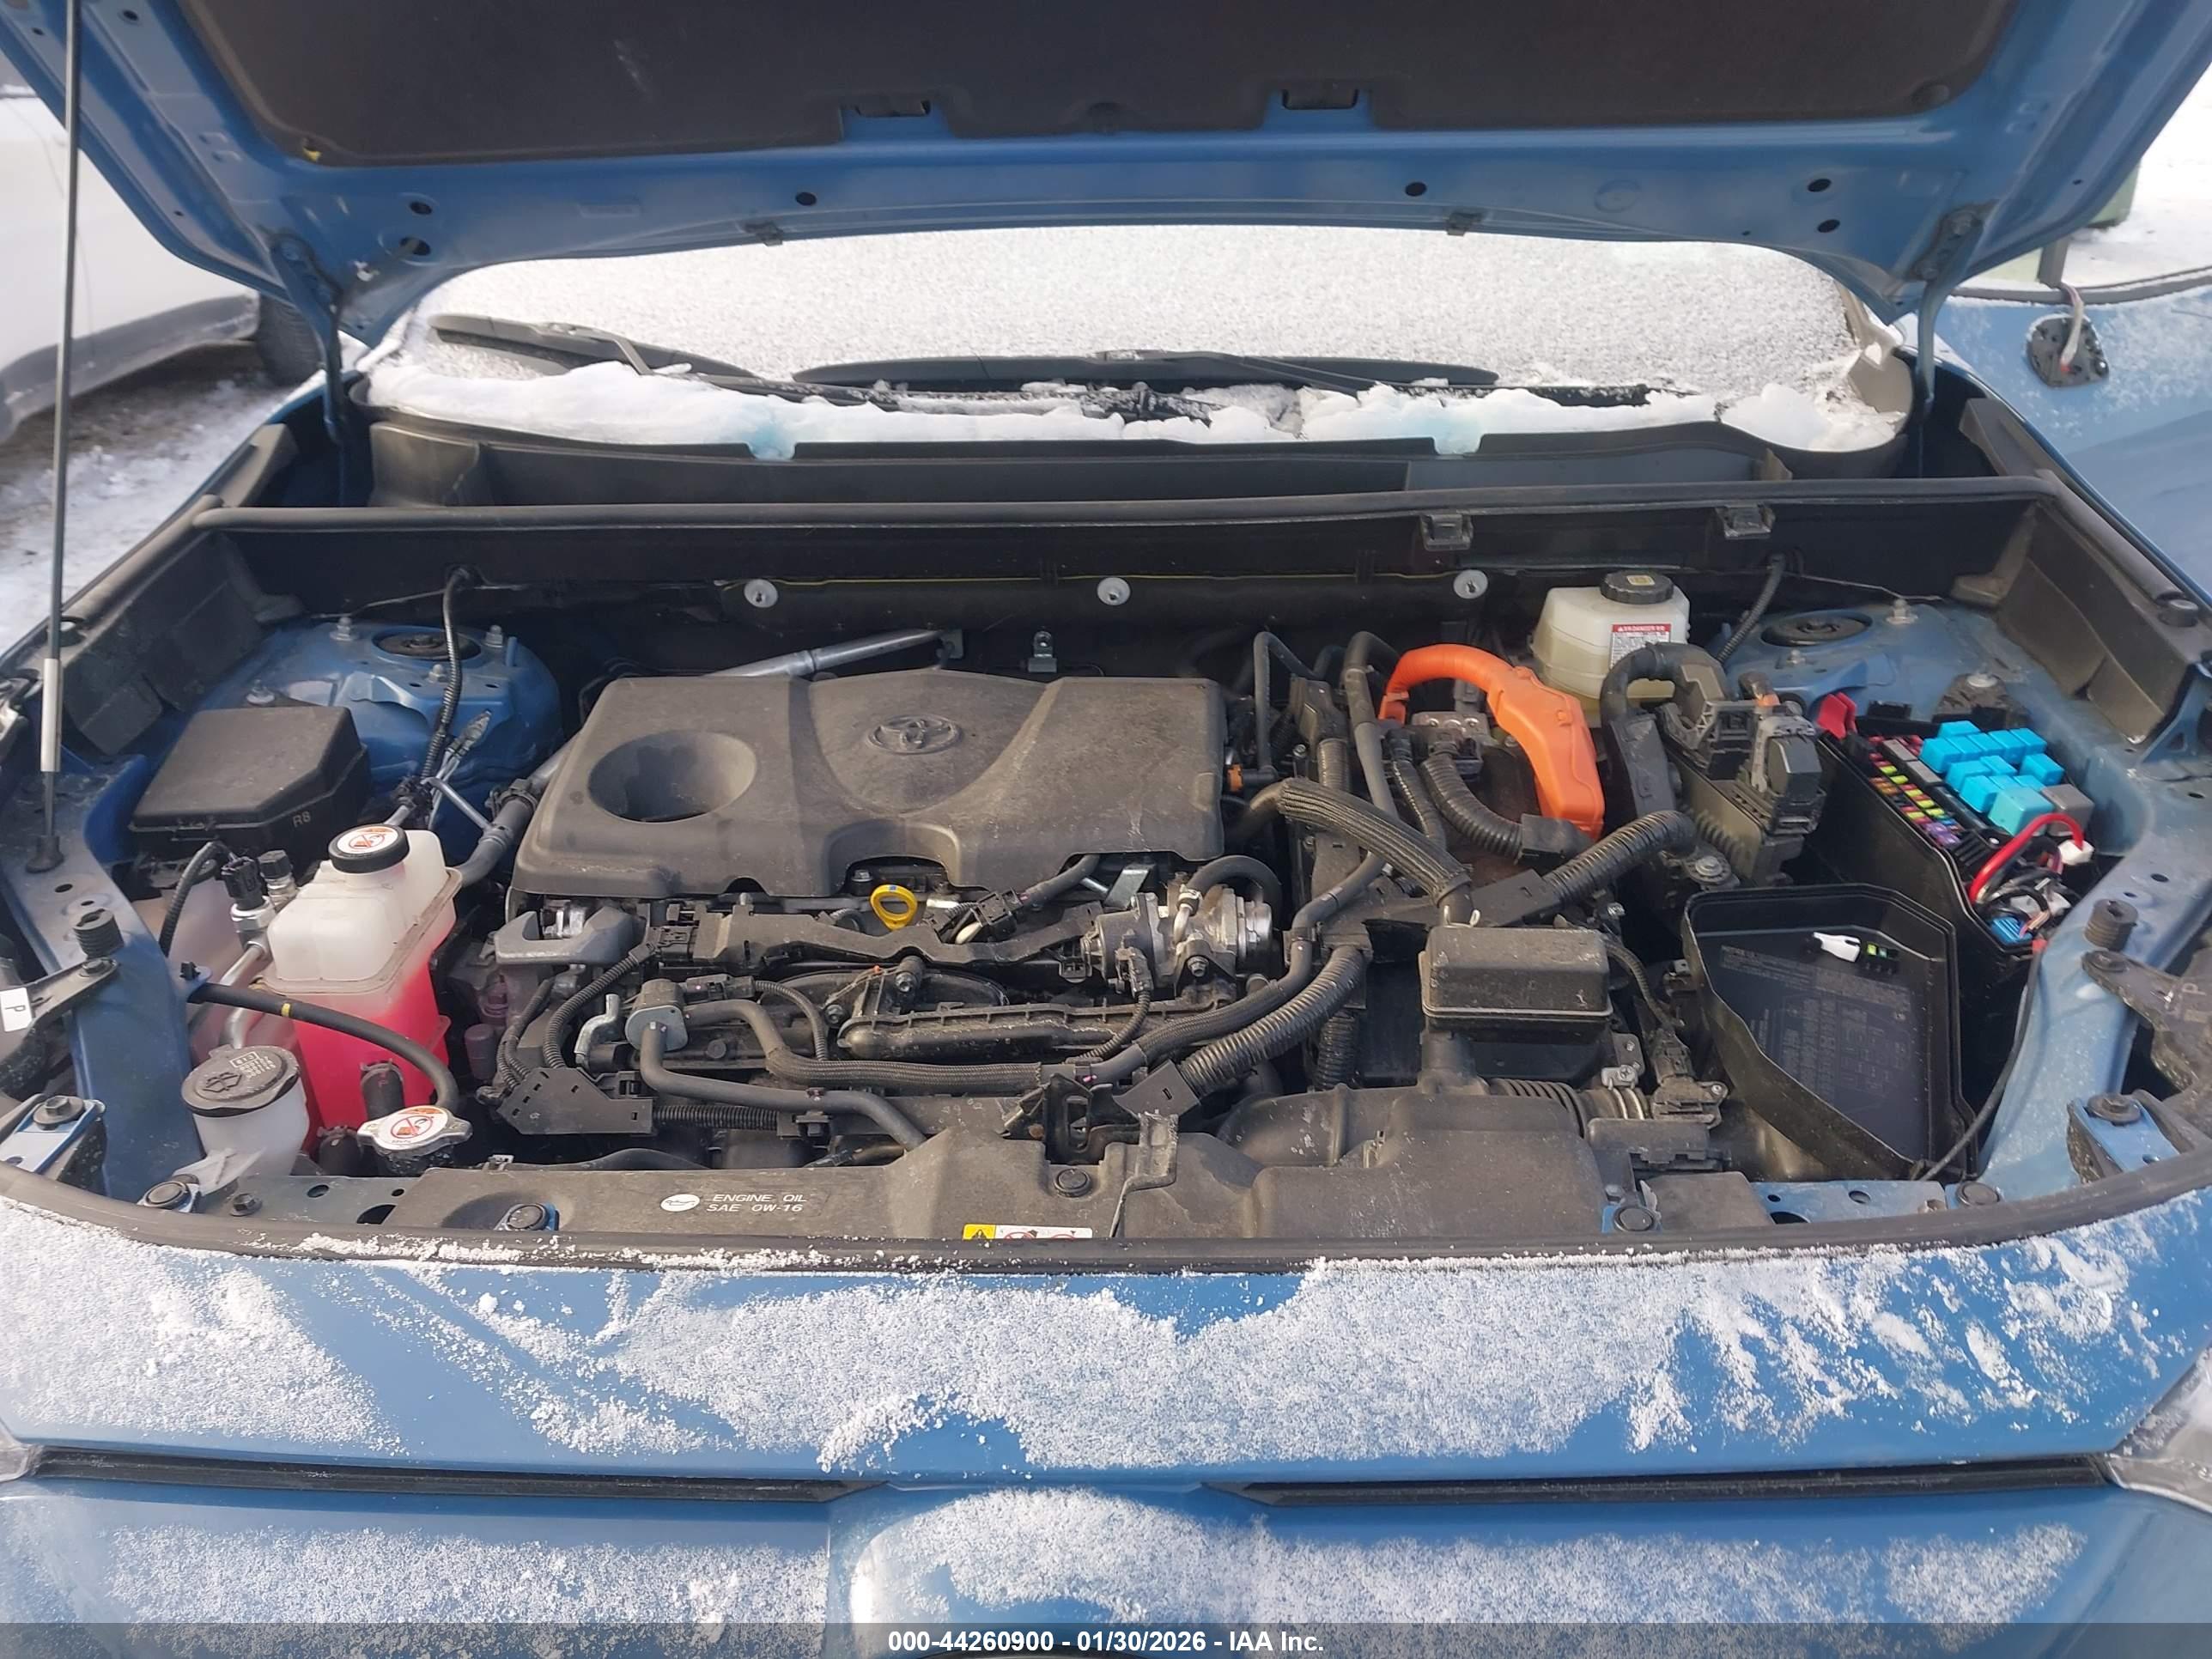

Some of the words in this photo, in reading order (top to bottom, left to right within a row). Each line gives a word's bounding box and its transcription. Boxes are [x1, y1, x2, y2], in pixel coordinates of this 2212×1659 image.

[292, 811, 311, 828] R8
[4, 1004, 27, 1012] P
[713, 1194, 773, 1202] ENGINE
[782, 1194, 807, 1202] OIL
